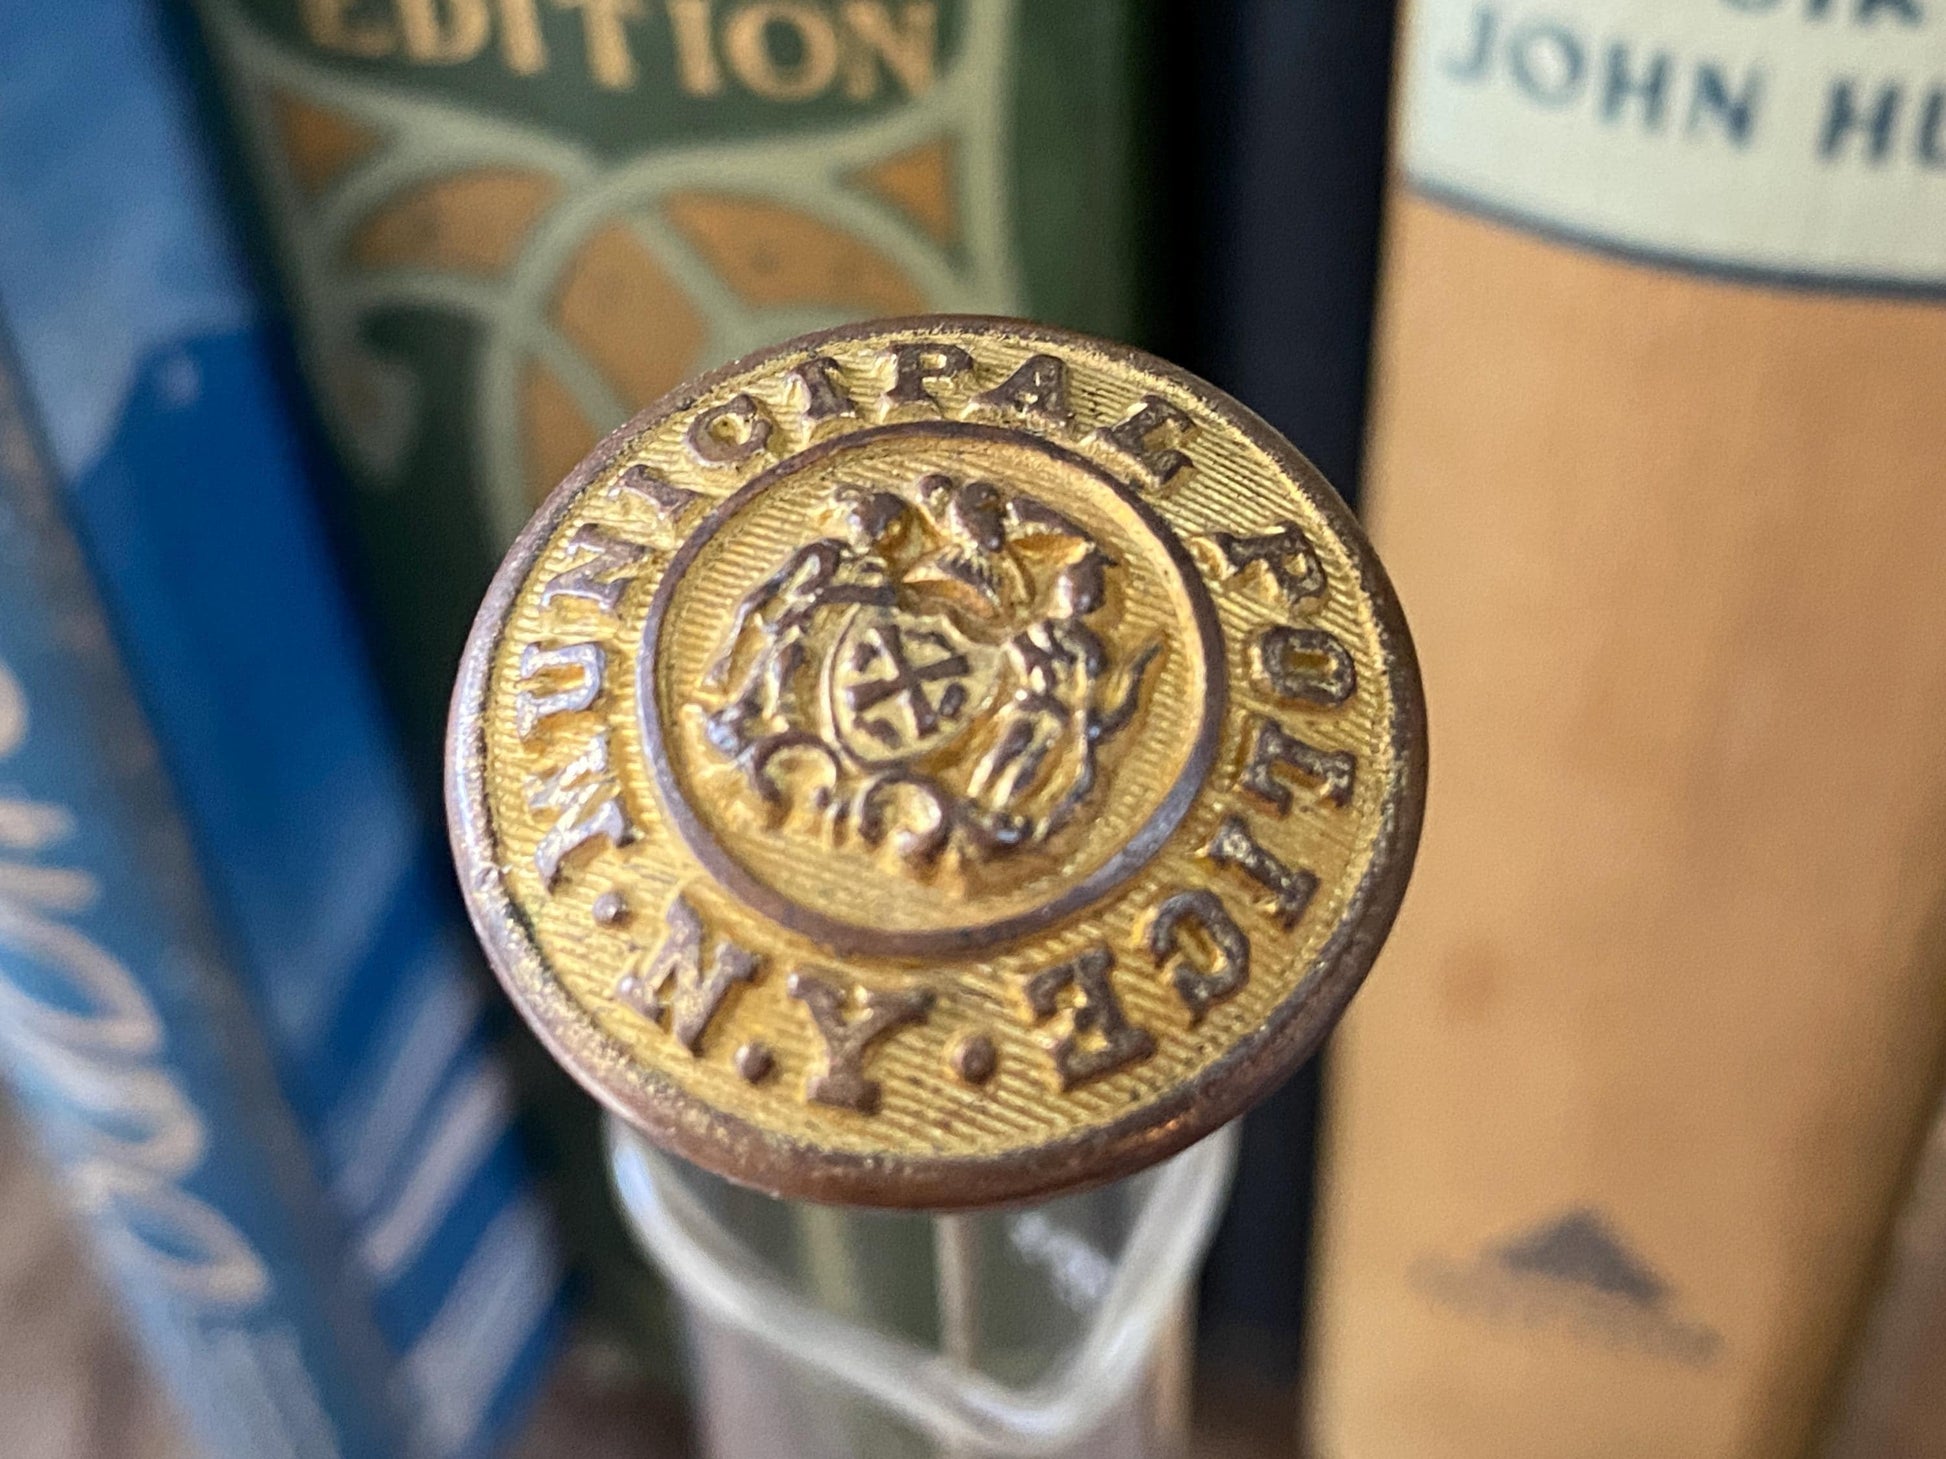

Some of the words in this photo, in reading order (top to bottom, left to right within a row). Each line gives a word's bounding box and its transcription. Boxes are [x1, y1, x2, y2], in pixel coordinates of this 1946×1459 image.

[302, 0, 938, 101] EDITION
[1444, 3, 1768, 150] JOHN
[516, 342, 1198, 893] MUNICIPAL
[1027, 523, 1359, 1094] POLICE
